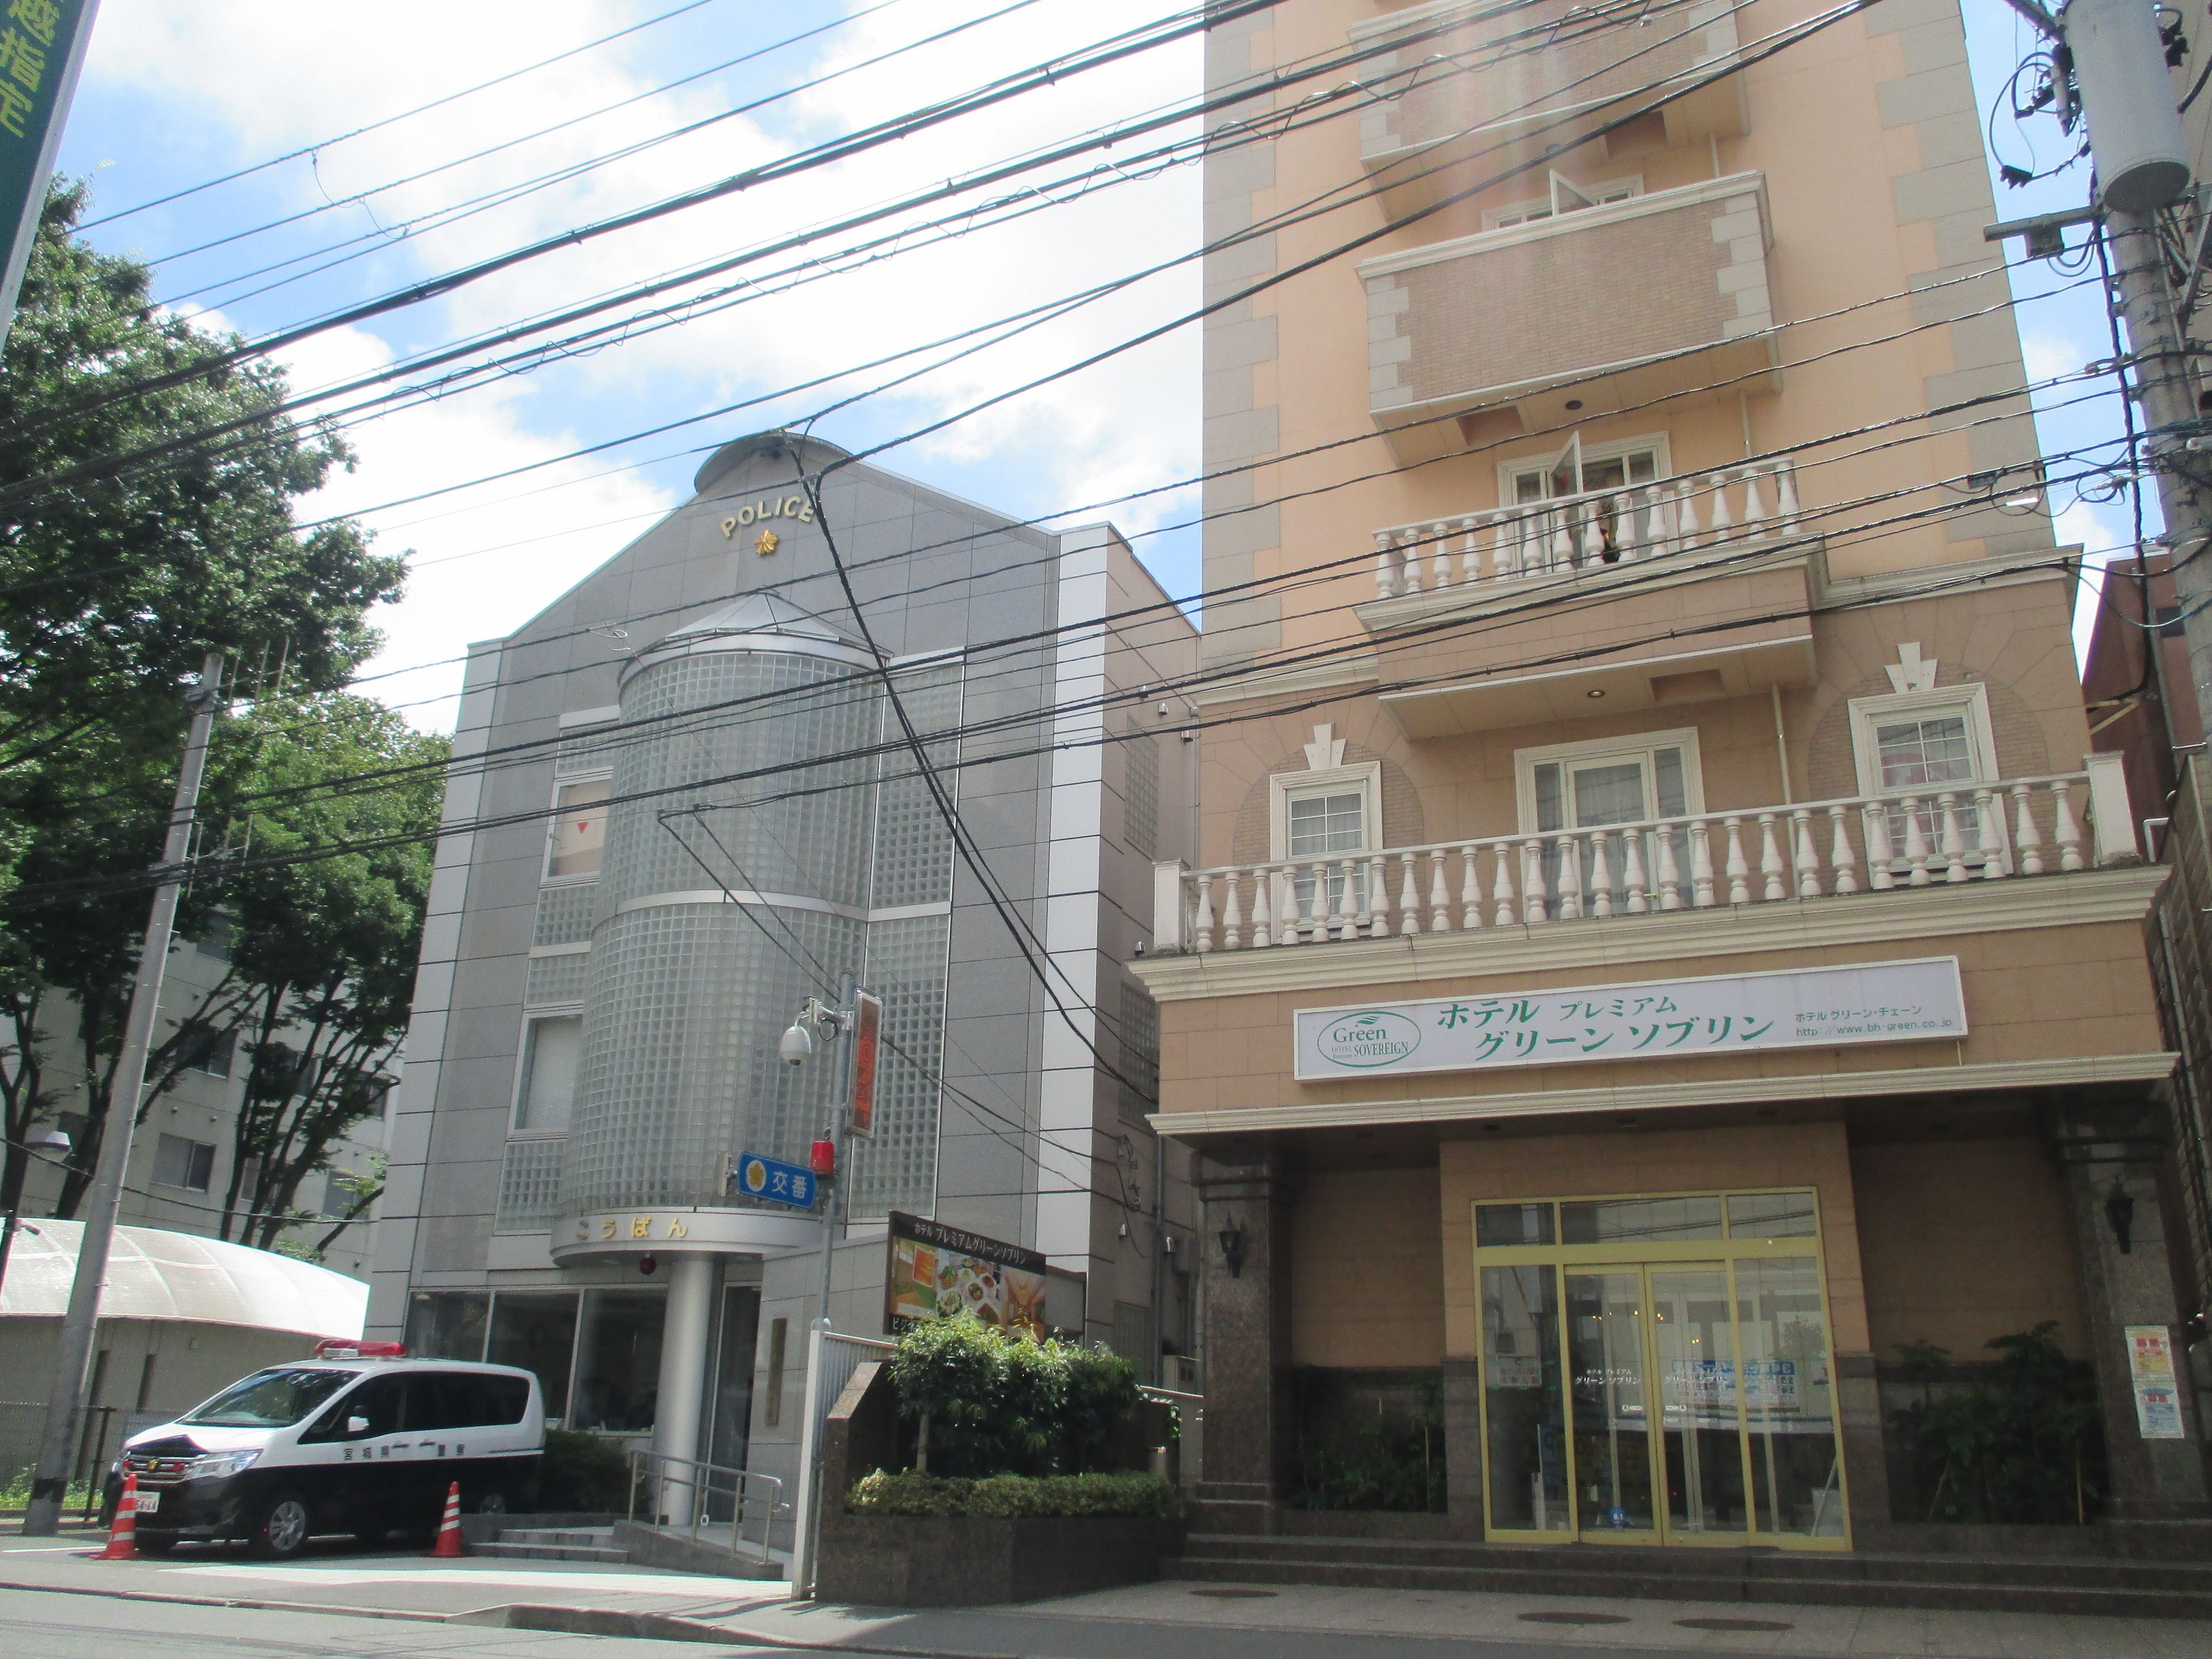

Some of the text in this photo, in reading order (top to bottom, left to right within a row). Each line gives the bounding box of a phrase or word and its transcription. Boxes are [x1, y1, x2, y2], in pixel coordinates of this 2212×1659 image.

[720, 496, 816, 539] POLICE
[1437, 996, 1677, 1029] ホテル プレミアム
[1796, 1012, 1827, 1022] ホテル
[1333, 1027, 1387, 1043] Green
[1475, 1016, 1774, 1060] グリーン ソブリン
[1354, 1041, 1409, 1057] SOVEREIGN
[771, 1171, 806, 1199] 交番
[575, 1217, 688, 1239] こうばん
[914, 1222, 1027, 1264] ホテル プレミアムグリーンソブリン
[1574, 1376, 1641, 1385] グリーン ソブリン
